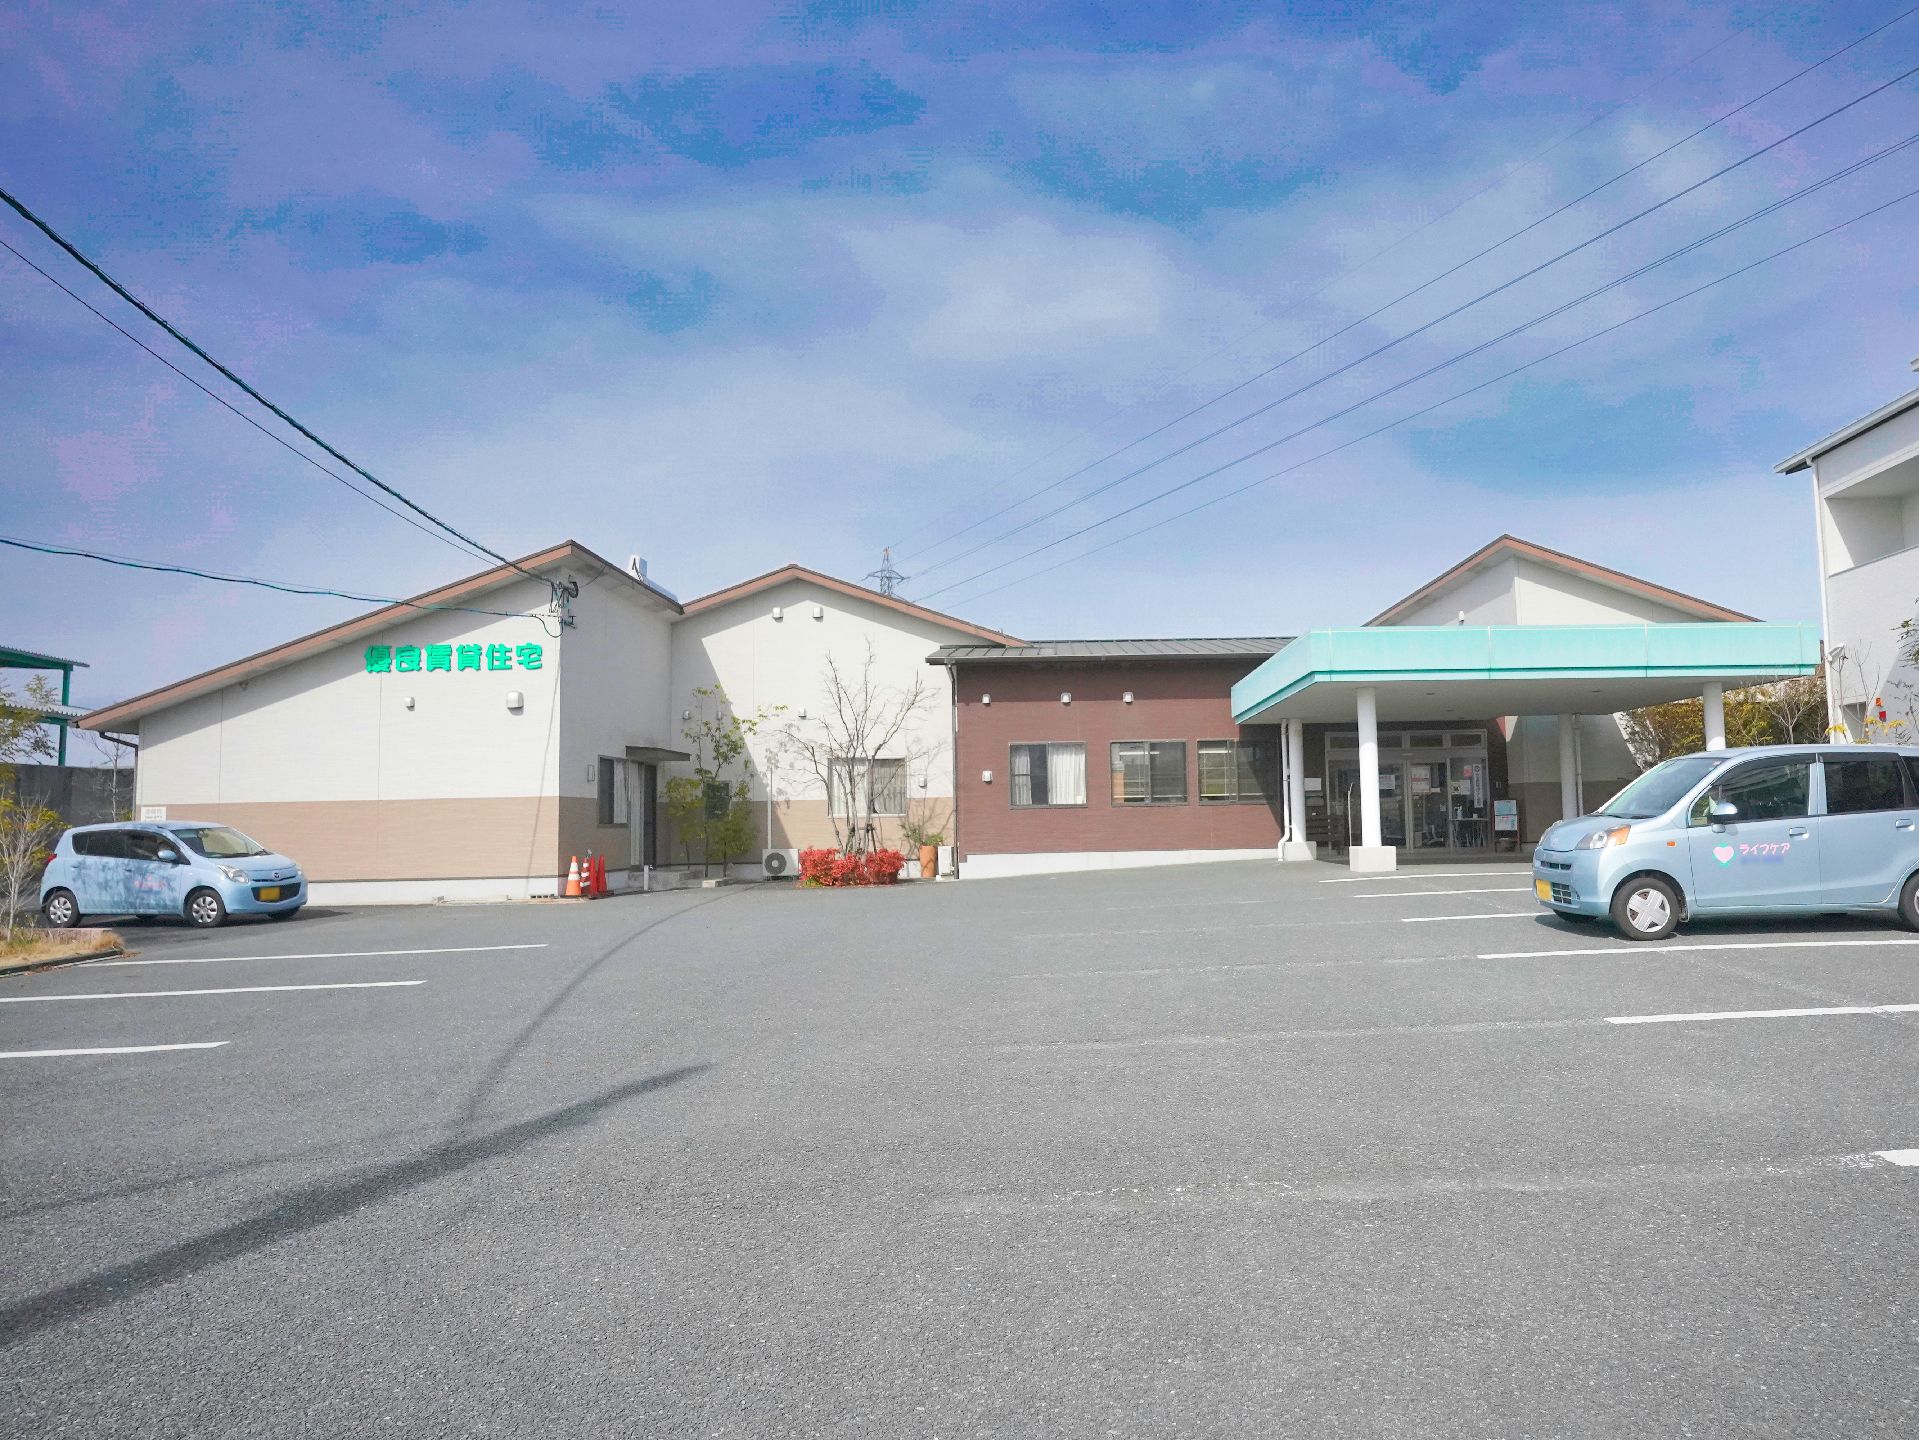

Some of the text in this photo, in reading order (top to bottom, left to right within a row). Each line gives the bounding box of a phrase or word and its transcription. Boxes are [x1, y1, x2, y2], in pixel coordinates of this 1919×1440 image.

[364, 642, 543, 673] 優良賃貸住宅
[1739, 843, 1790, 855] ライフケア
